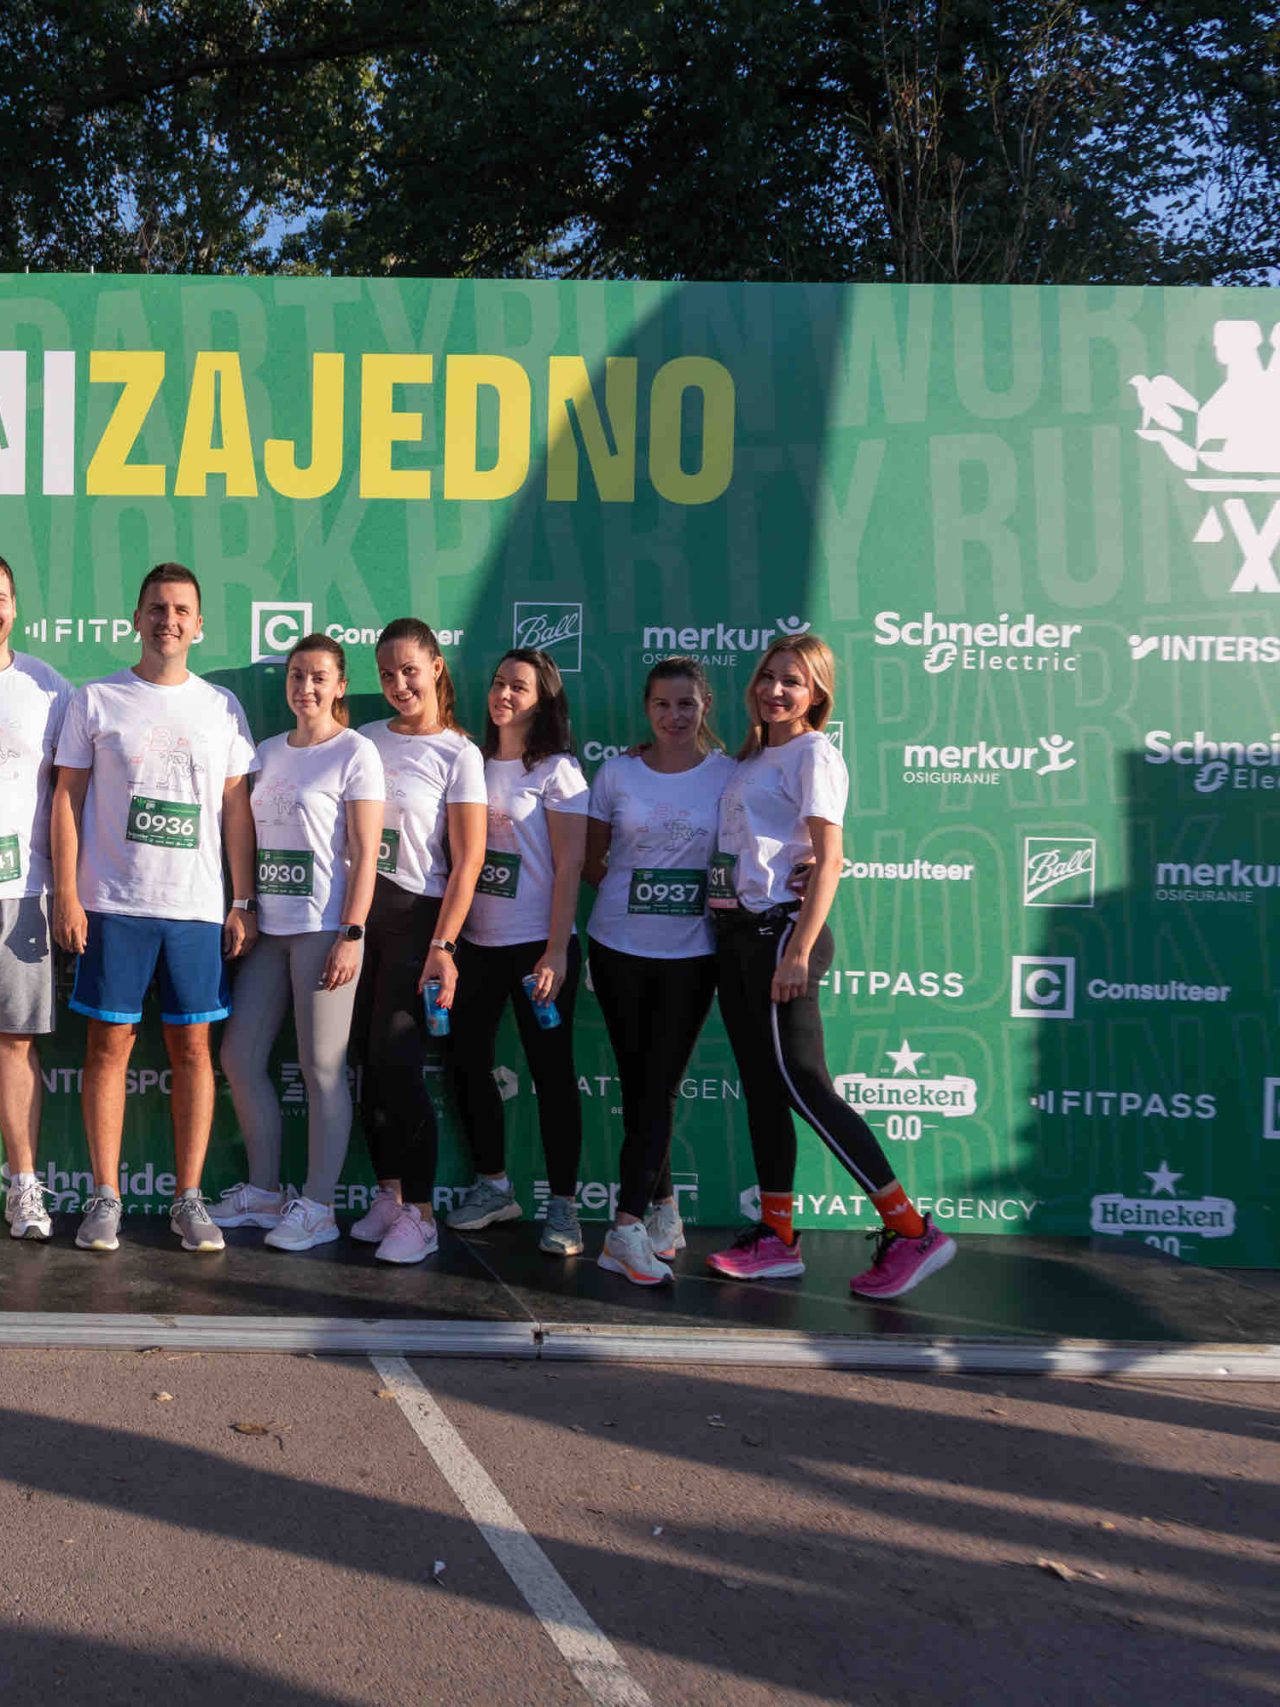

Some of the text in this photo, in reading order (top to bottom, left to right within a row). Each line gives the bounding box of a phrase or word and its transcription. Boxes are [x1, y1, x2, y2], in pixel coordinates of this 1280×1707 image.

[264, 614, 300, 650] C
[517, 613, 581, 650] Ball
[643, 623, 775, 651] merkur
[874, 611, 1082, 647] Schneider
[963, 649, 1077, 671] Electric
[904, 742, 1038, 771] merkur
[903, 771, 1000, 785] OSIGURANJE
[135, 812, 194, 836] 0936
[259, 864, 306, 883] 0930
[481, 865, 511, 885] 39
[711, 867, 726, 887] 31
[1026, 848, 1094, 901] Ball
[636, 884, 700, 903] 0937
[1156, 889, 1253, 902] OSIGURANJE
[1025, 970, 1232, 1005] C Consulteer
[843, 1083, 966, 1106] Heineken
[1061, 1091, 1217, 1118] FITPASS
[1100, 1203, 1224, 1227] Heineken
